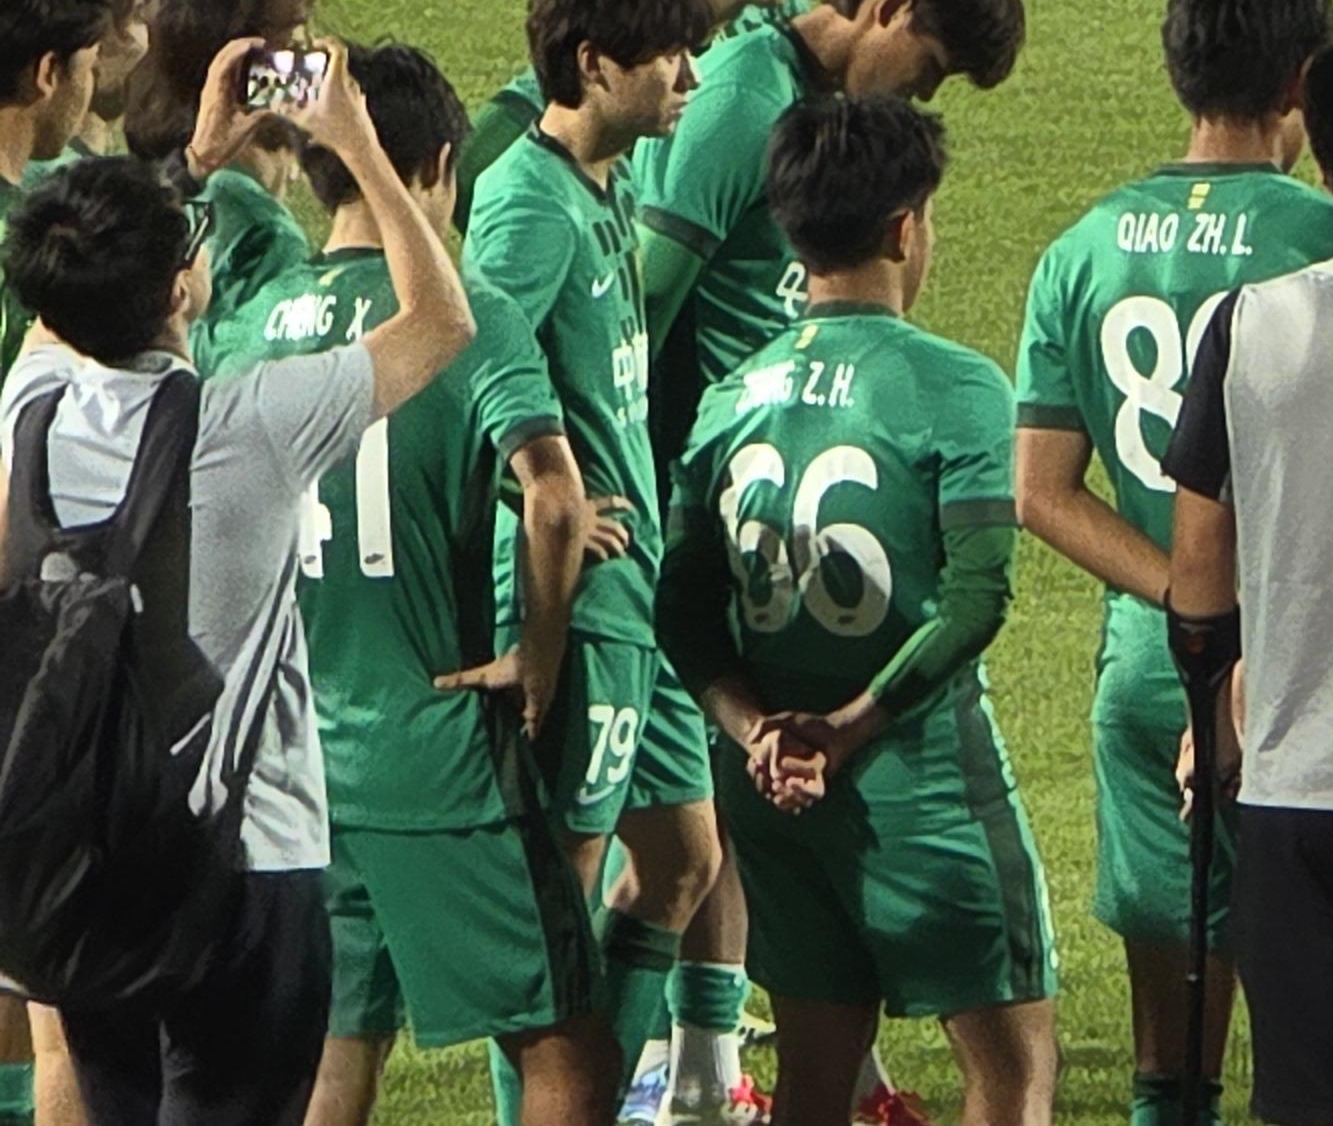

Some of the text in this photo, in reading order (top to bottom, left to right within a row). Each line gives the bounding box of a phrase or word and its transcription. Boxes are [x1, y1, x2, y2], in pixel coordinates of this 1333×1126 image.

[1117, 211, 1179, 253] QIAO
[1101, 295, 1229, 493] 8
[719, 443, 892, 636] 66
[586, 704, 639, 784] 79
